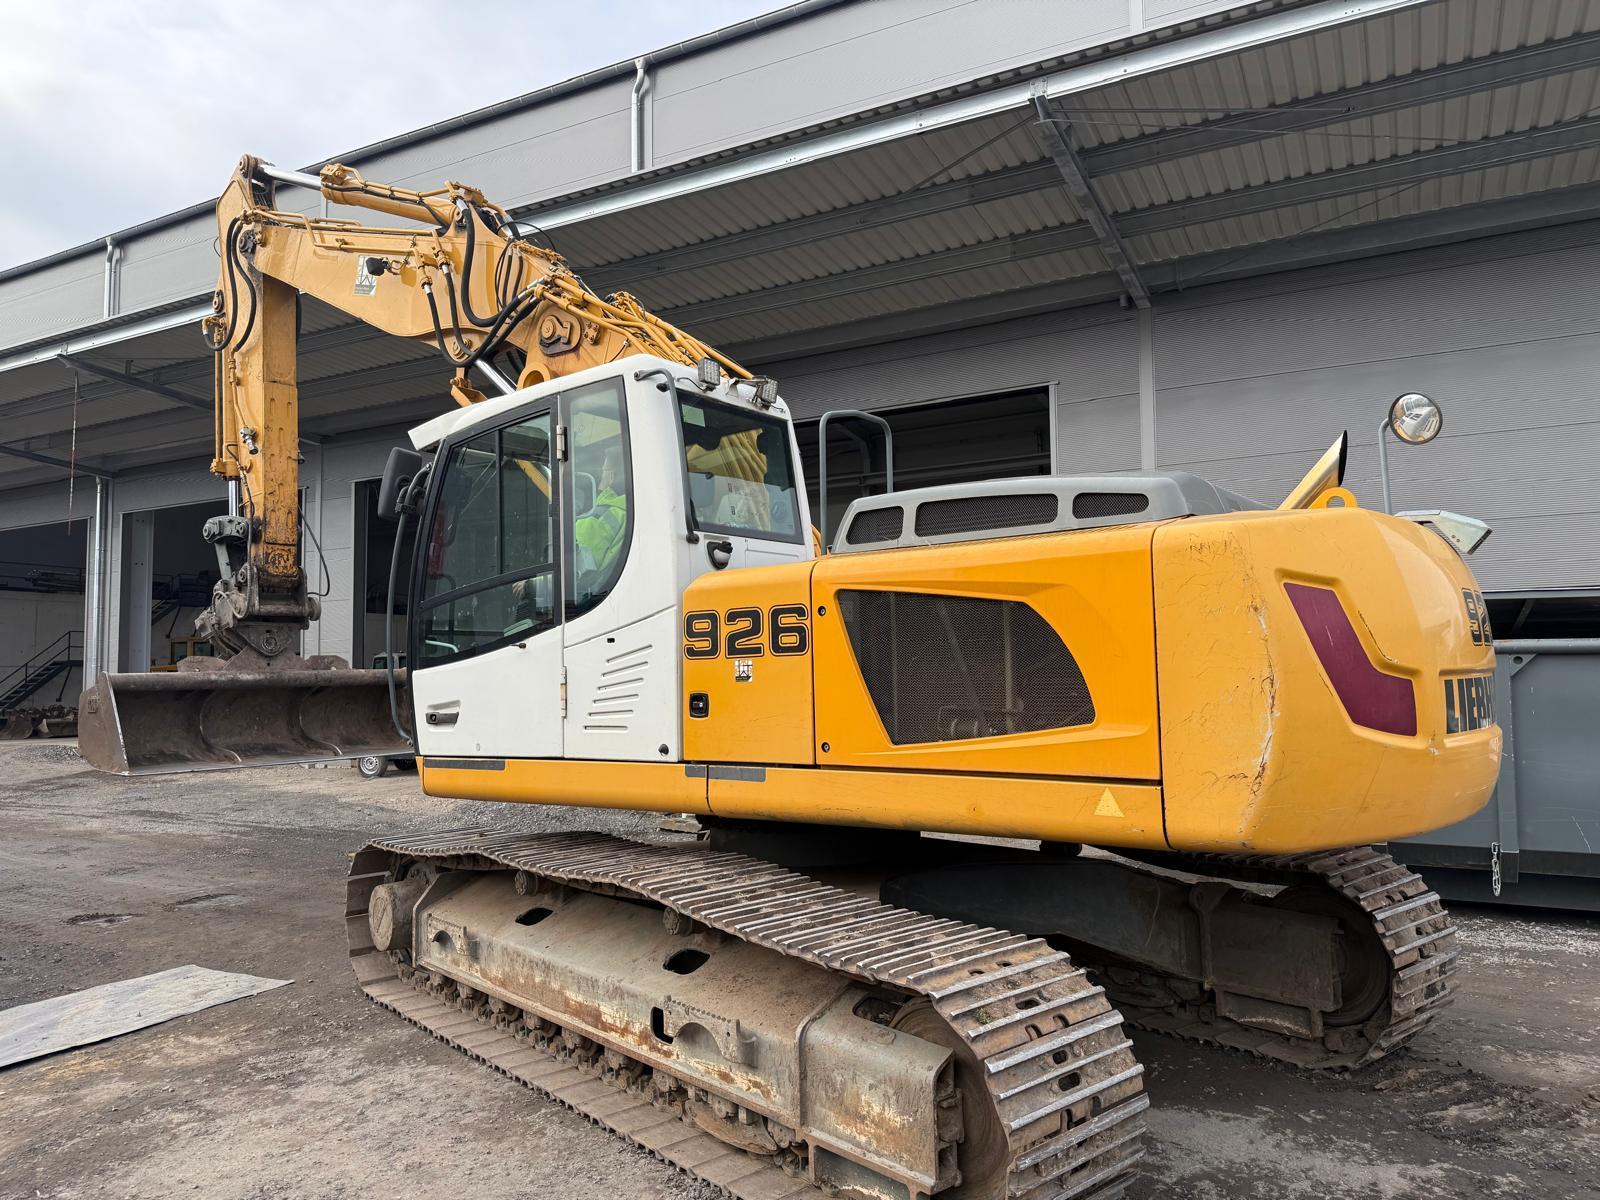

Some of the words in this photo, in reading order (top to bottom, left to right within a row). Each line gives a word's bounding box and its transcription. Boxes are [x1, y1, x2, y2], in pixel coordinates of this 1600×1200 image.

[684, 603, 809, 660] 926
[1461, 587, 1493, 647] 92
[1444, 676, 1494, 734] LIEBH
